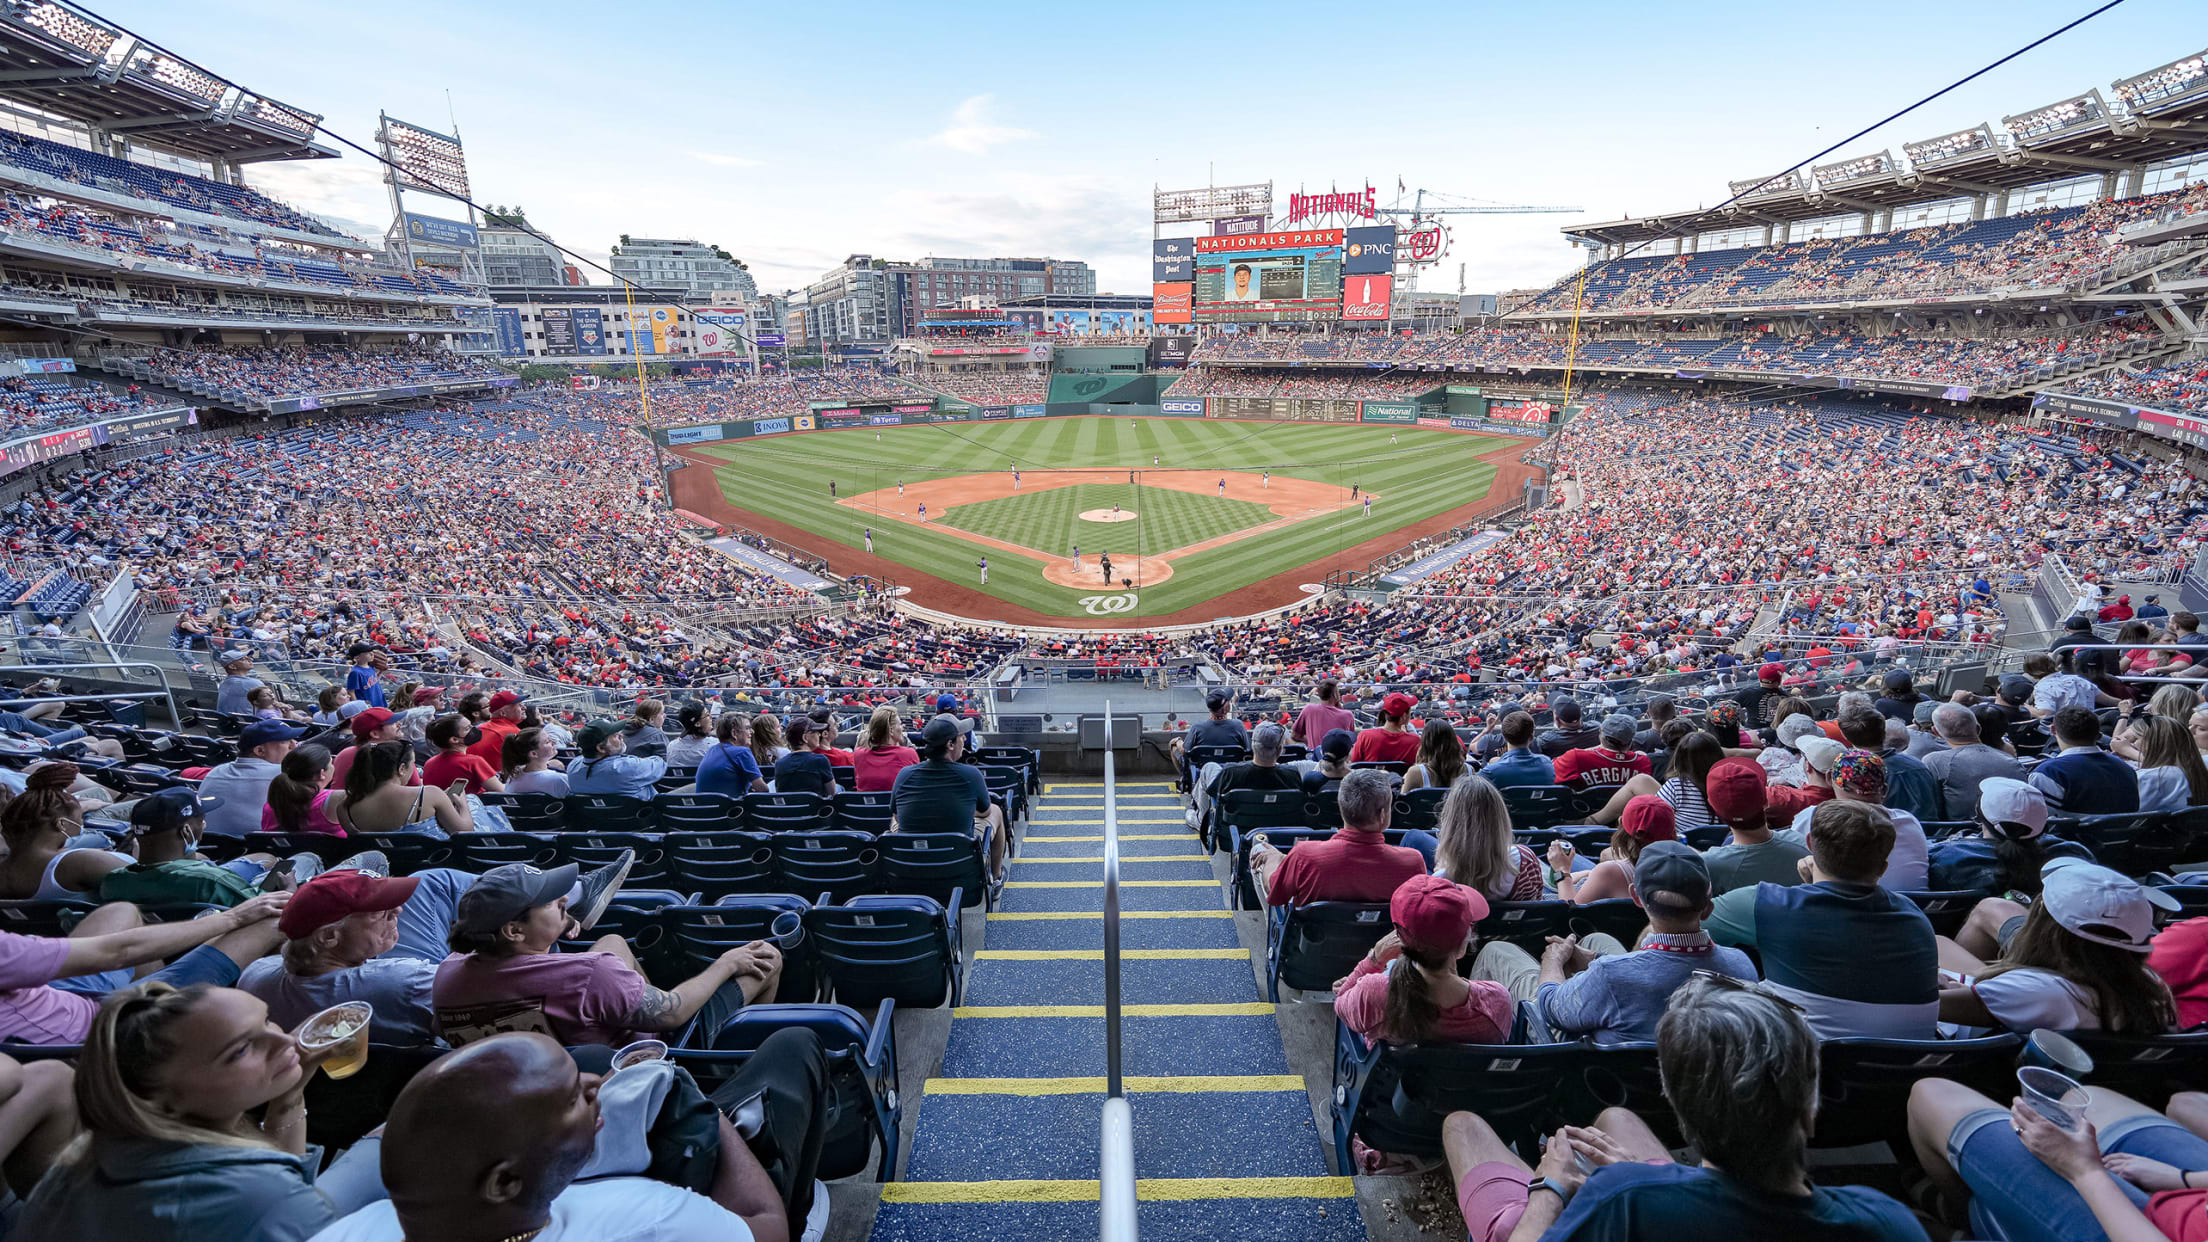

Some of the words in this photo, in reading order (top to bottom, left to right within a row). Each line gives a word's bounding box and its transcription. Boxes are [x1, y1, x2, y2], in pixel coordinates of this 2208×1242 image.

[1290, 187, 1376, 223] NATIONALS
[1227, 220, 1258, 233] NATITUDE
[1201, 235, 1286, 249] NATIONALS
[1294, 232, 1334, 244] PARK
[1166, 244, 1179, 252] The
[1364, 243, 1392, 255] PNC
[1154, 254, 1191, 264] Washington
[1165, 265, 1180, 275] Post
[1344, 302, 1386, 317] Coca-Cola
[697, 315, 745, 325] GEICO
[1163, 402, 1201, 412] GEICO
[1377, 407, 1412, 415] National
[763, 421, 788, 431] INOVA
[1078, 593, 1139, 615] W
